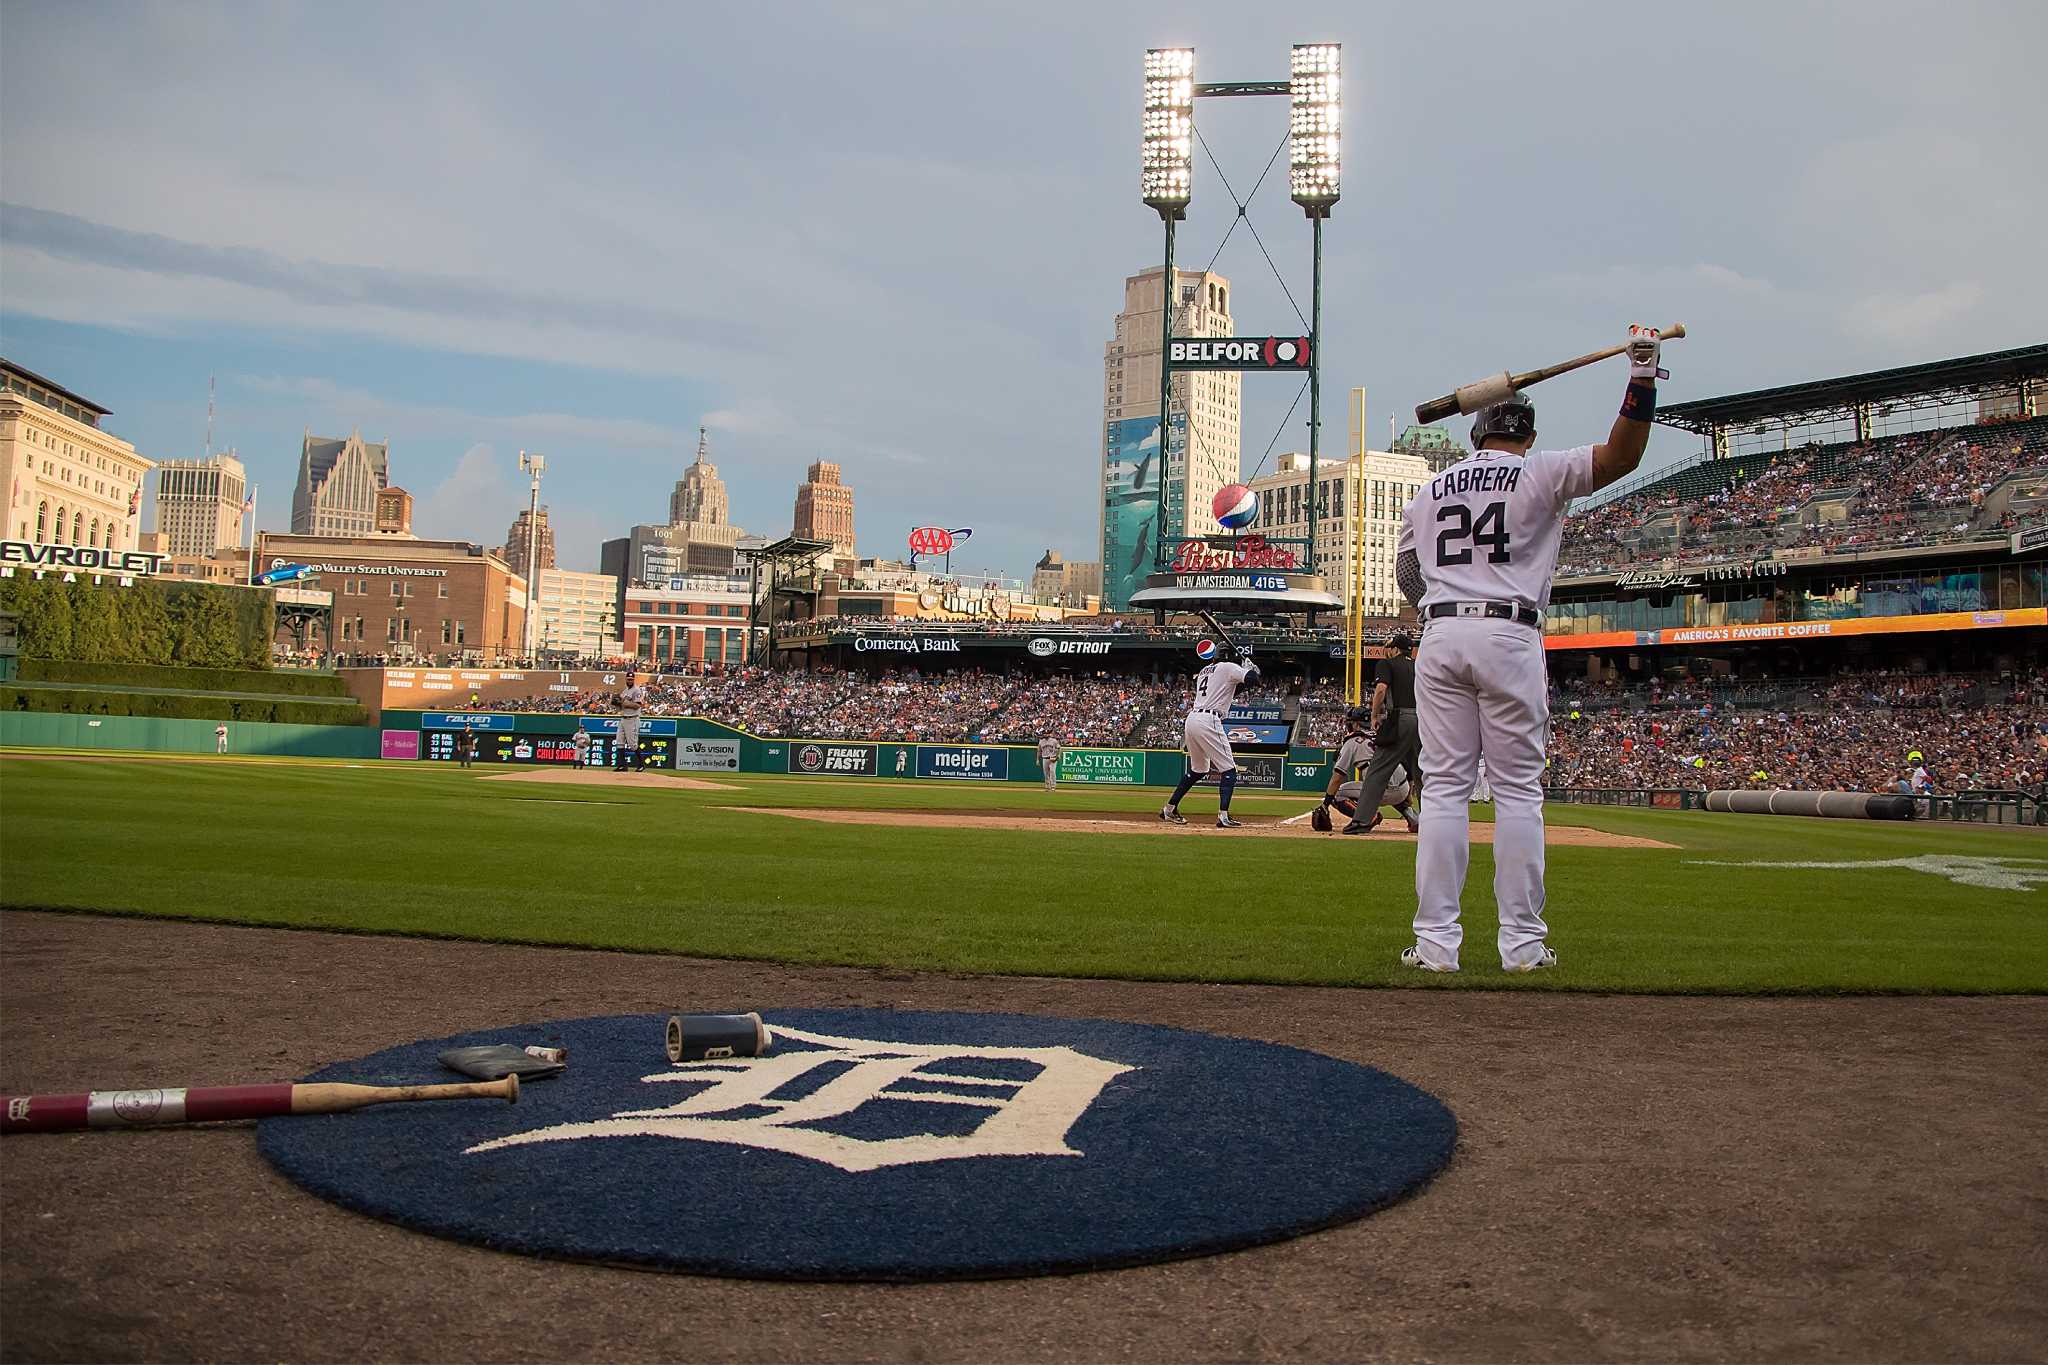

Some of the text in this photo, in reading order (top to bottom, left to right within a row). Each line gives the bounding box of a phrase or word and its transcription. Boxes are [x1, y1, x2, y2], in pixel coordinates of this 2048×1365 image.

[1170, 343, 1259, 361] BELFOR
[1432, 467, 1522, 500] CABRERA
[654, 530, 673, 538] 1001
[1436, 502, 1511, 567] 24
[911, 529, 950, 555] AAA
[321, 563, 357, 574] VALLEY
[357, 564, 388, 575] STATE
[388, 565, 448, 577] UNIVERSITY
[1704, 562, 1787, 581] TIGER CLUB
[1176, 576, 1193, 588] NEW
[1195, 576, 1250, 588] AMSTERDAM
[1674, 624, 1830, 641] AMERICA'S FAVORITE COFFEE
[923, 638, 960, 651] Bank
[1059, 641, 1112, 654] DETROIT
[560, 673, 616, 685] 11 42
[1198, 676, 1209, 696] 4
[445, 715, 491, 723] FALKEN
[1256, 711, 1280, 720] TIRE
[603, 720, 652, 728] FAEN
[708, 746, 735, 754] VISION
[827, 748, 867, 758] FREAKY
[825, 757, 866, 770] FAST!
[935, 749, 989, 771] meijer
[1062, 751, 1134, 768] EASTERN
